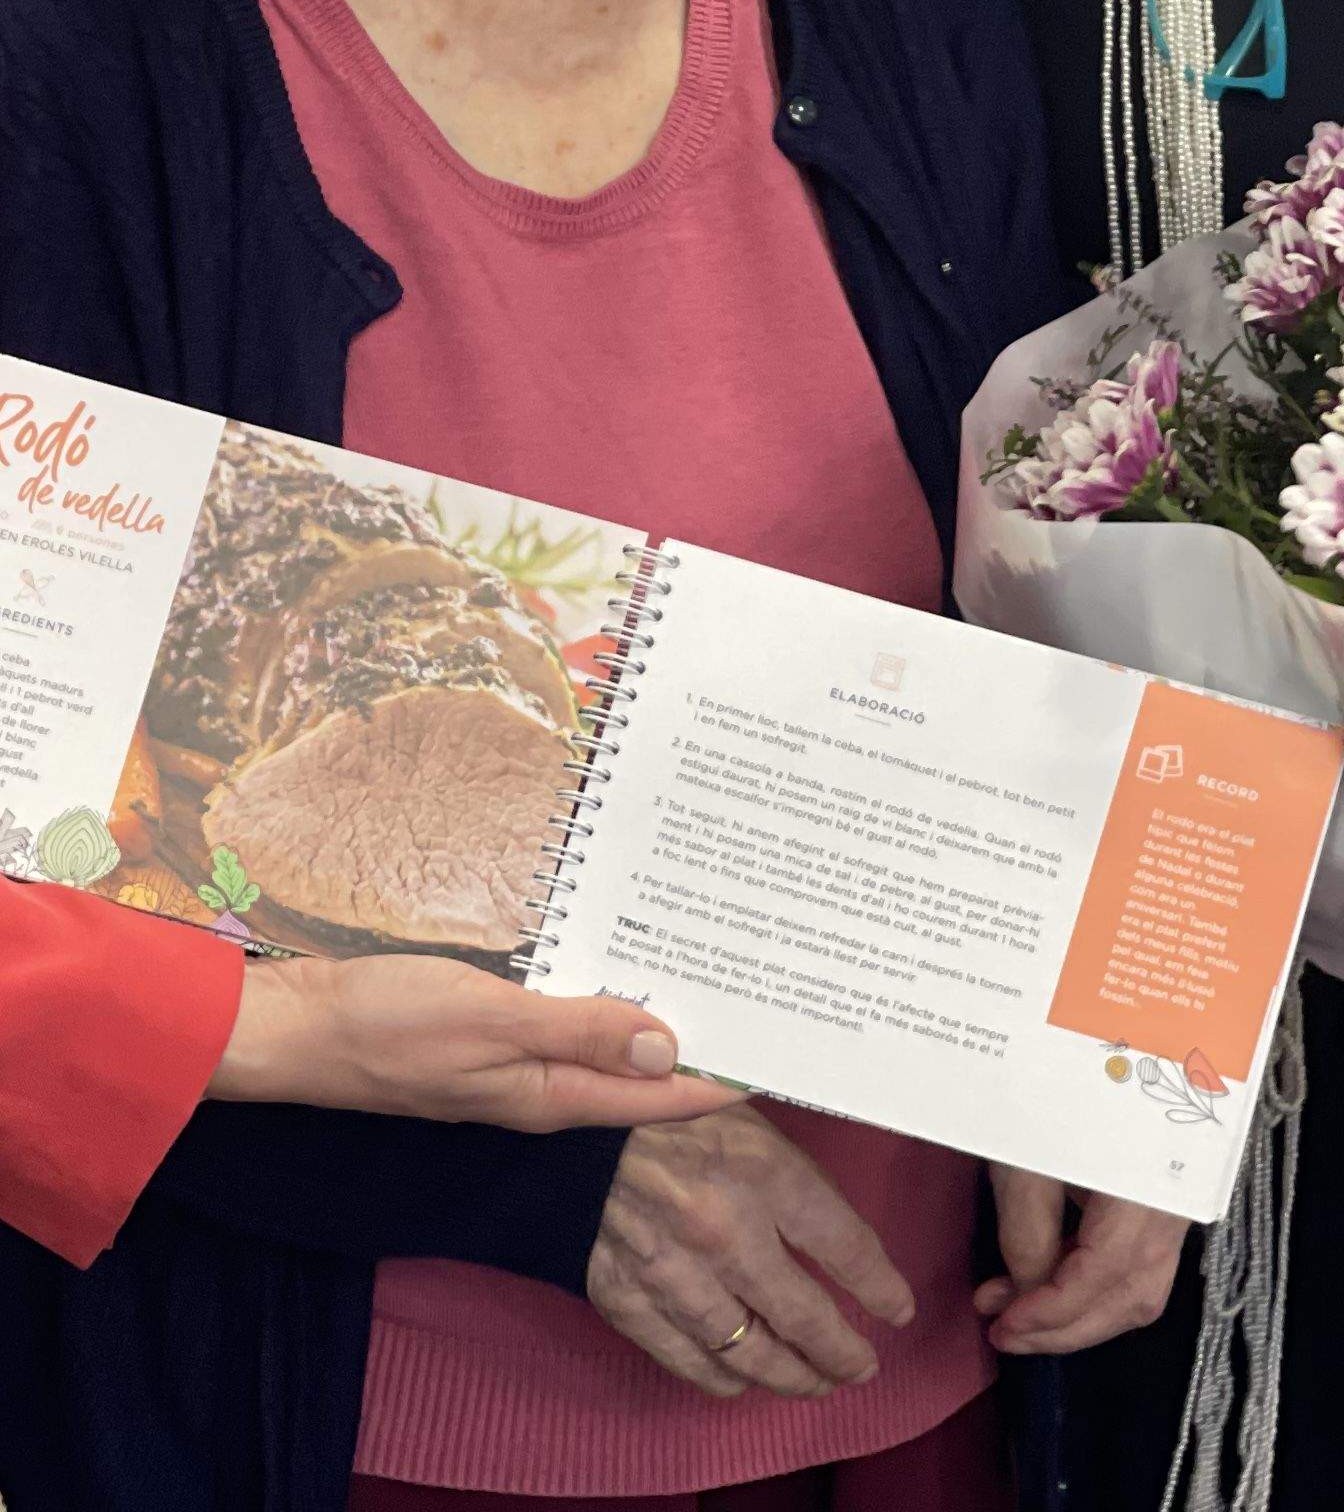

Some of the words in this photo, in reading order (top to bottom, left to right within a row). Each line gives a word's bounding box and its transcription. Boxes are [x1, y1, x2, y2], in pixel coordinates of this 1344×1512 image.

[17, 464, 54, 514] de
[62, 483, 166, 534] vedella
[20, 533, 76, 557] EROLES
[77, 549, 135, 574] VILELLA
[1, 649, 31, 666] ceba
[23, 688, 64, 710] pebrot
[65, 700, 94, 717] verd
[39, 676, 85, 698] madurs
[9, 700, 35, 716] d'all
[829, 687, 925, 724] ELABORACIÓ
[0, 713, 17, 727] de
[18, 719, 51, 736] llorer
[4, 731, 37, 749] blanc
[700, 714, 716, 725] en
[717, 717, 741, 733] fem
[742, 727, 759, 738] un
[697, 695, 715, 709] En
[714, 701, 755, 723] primer
[782, 721, 820, 741] tallem
[820, 733, 833, 745] la
[866, 747, 879, 759] el
[879, 751, 938, 779] tomàquet
[944, 770, 957, 782] el
[1002, 788, 1022, 802] tot
[1021, 794, 1046, 809] ben
[1046, 801, 1076, 821] petit
[1197, 774, 1259, 801] RECORD
[674, 769, 722, 792] mateixa
[722, 784, 770, 807] escalfor
[771, 799, 834, 828] s'impregni
[835, 818, 851, 831] bé
[852, 823, 865, 835] el
[865, 827, 894, 846] gust
[894, 836, 907, 848] al
[678, 755, 720, 777] estigui
[764, 780, 777, 792] hi
[777, 786, 818, 807] posem
[819, 799, 836, 811] un
[837, 803, 862, 820] raig
[863, 810, 880, 824] de
[881, 816, 893, 828] vi
[894, 820, 928, 838] blanc
[934, 832, 991, 857] deixarem
[991, 851, 1016, 867] que
[1016, 857, 1045, 874] amb
[1046, 866, 1058, 878] la
[661, 848, 682, 862] foc
[682, 854, 707, 870] lent
[719, 865, 742, 880] fins
[742, 874, 766, 890] que
[767, 881, 838, 912] comprovem
[839, 903, 864, 919] que
[865, 909, 892, 925] està
[920, 926, 933, 938] al
[655, 927, 668, 939] El
[669, 931, 708, 951] secret
[708, 943, 761, 969] d'aquest
[761, 959, 786, 977] plat
[788, 967, 848, 993] considero
[848, 987, 873, 1003] que
[875, 993, 890, 1006] és
[892, 998, 936, 1020] l'afecte
[937, 1014, 962, 1030] que
[963, 1022, 1009, 1044] sempre
